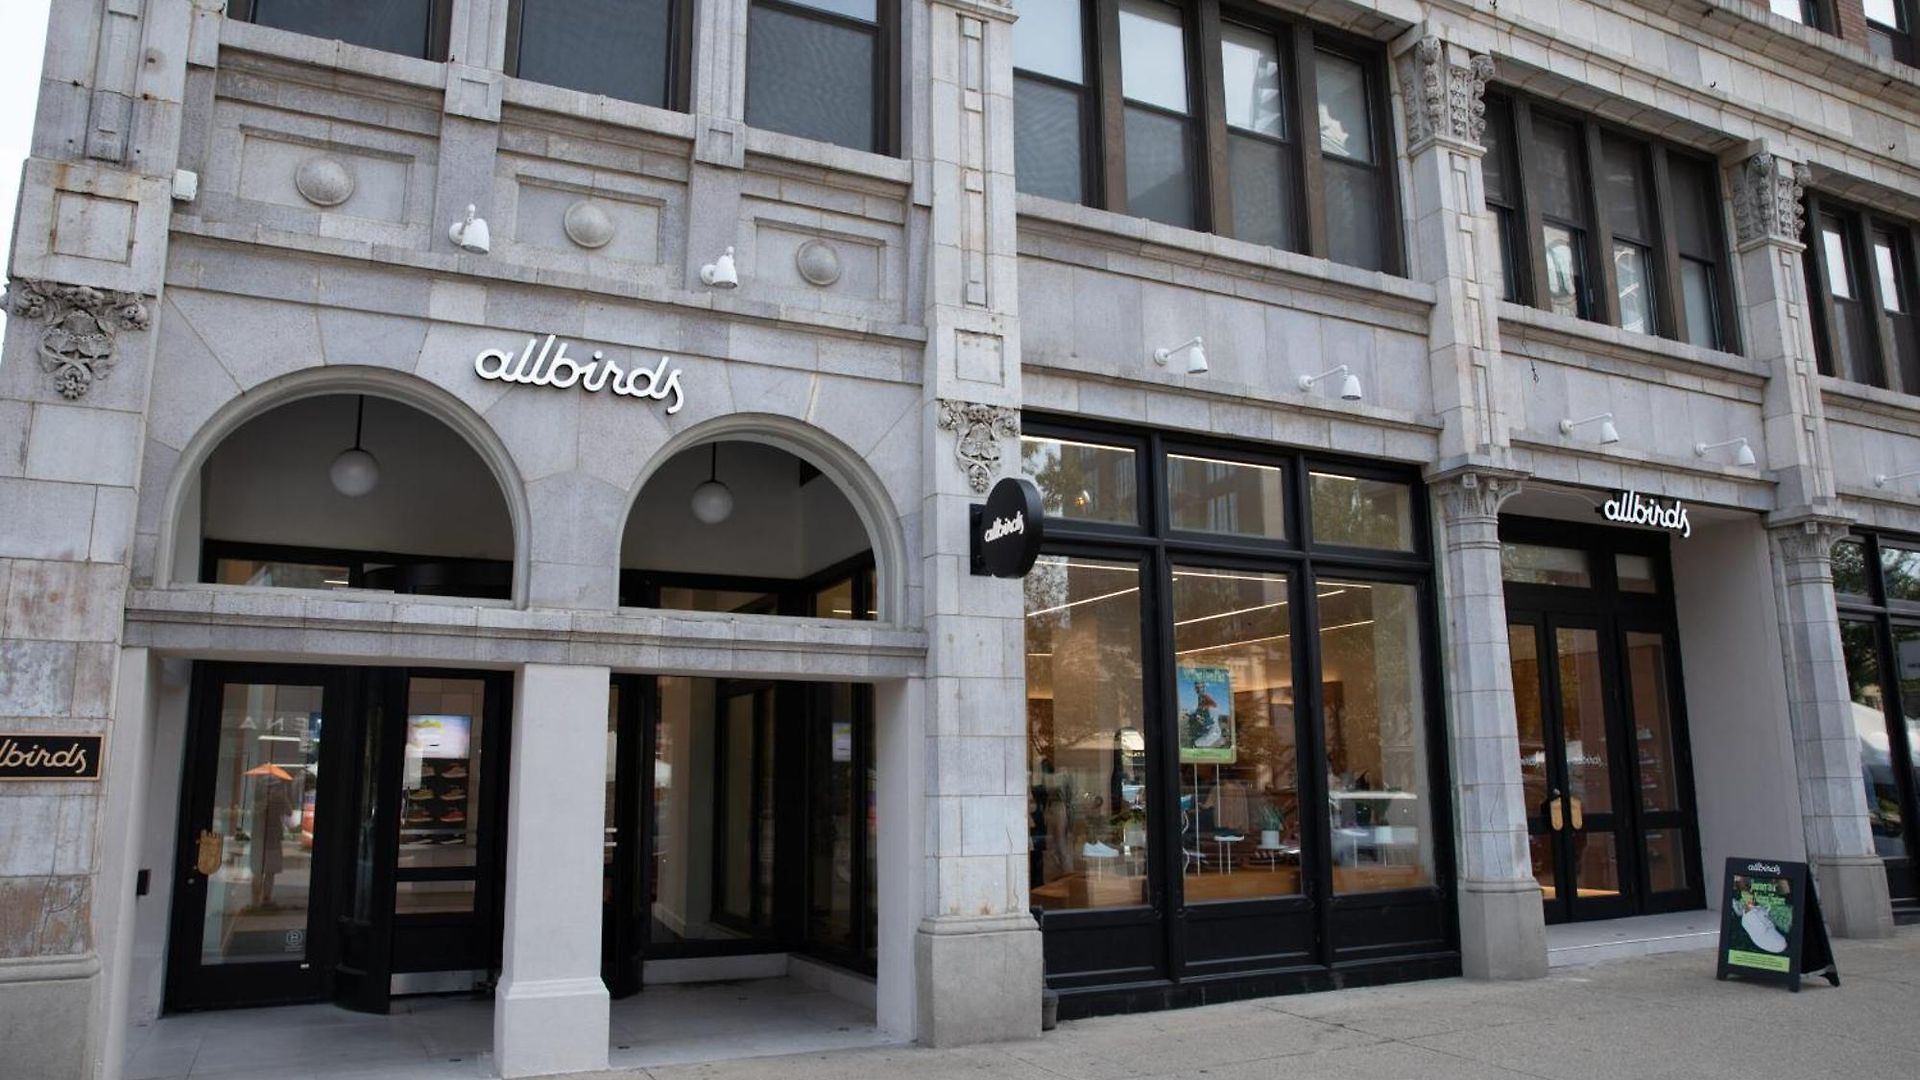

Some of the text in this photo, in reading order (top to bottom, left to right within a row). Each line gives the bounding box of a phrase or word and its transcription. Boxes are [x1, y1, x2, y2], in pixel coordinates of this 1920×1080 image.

[474, 334, 684, 415] allbirds
[984, 511, 1024, 542] allbirds
[1604, 490, 1690, 538] allbirds
[1747, 862, 1781, 875] allbirds
